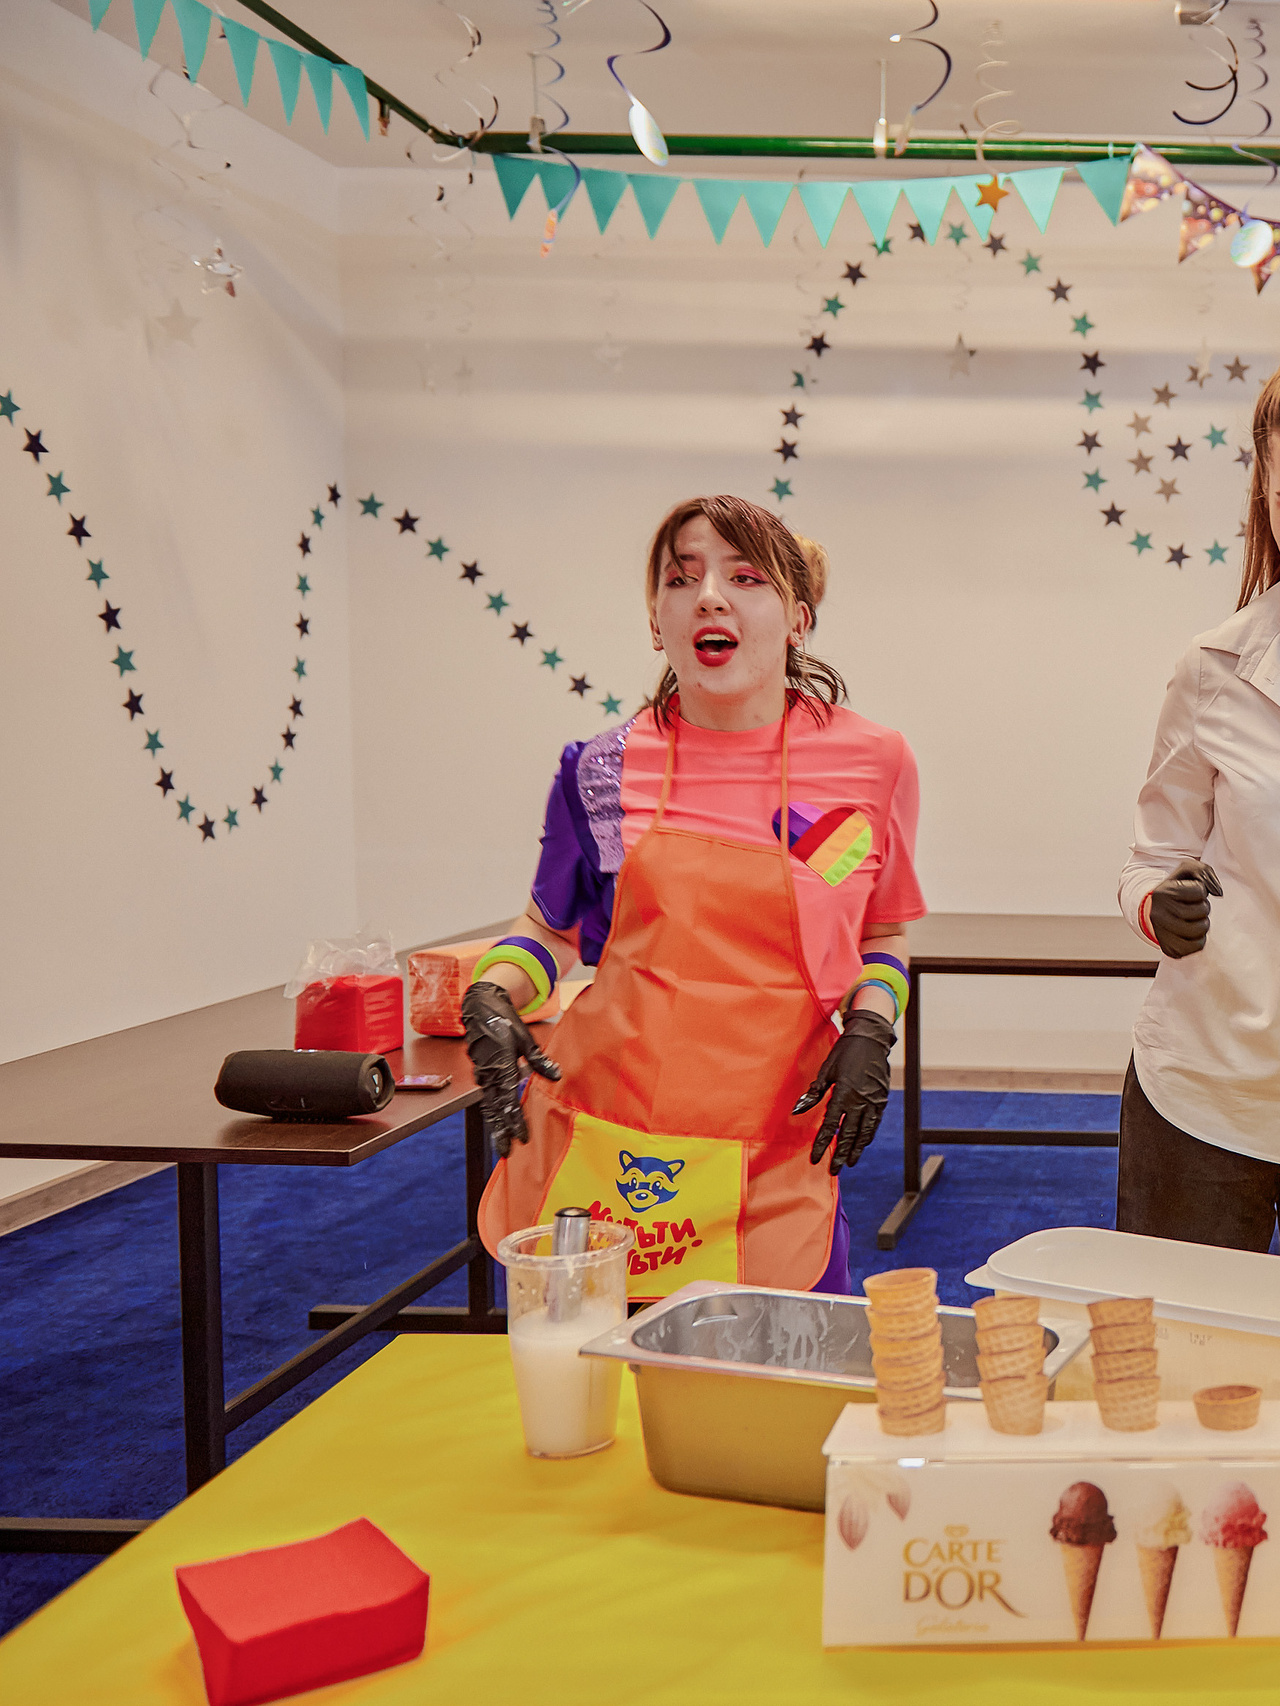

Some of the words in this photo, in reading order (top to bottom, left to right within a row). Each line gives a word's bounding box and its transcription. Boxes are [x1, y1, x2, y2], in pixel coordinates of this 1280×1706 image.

[587, 1200, 697, 1250] МЬТИ
[902, 1537, 1006, 1568] CARTE
[903, 1566, 1028, 1619] D'OR
